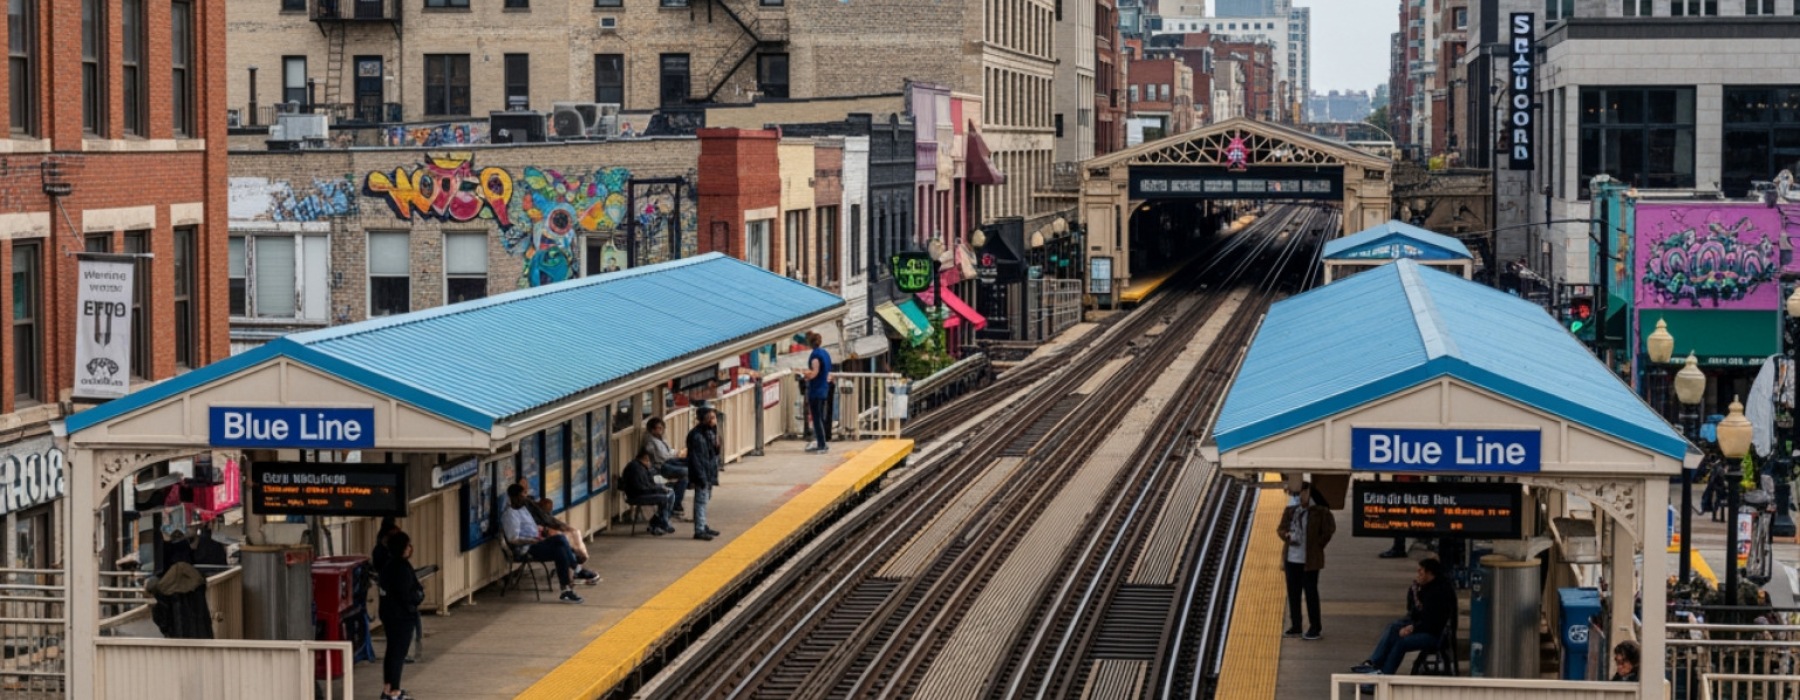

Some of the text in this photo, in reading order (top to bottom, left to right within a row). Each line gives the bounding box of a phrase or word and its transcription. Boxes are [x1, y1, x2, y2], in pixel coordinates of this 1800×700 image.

[224, 412, 361, 441] Blue Line
[1369, 434, 1526, 464] Blue Line
